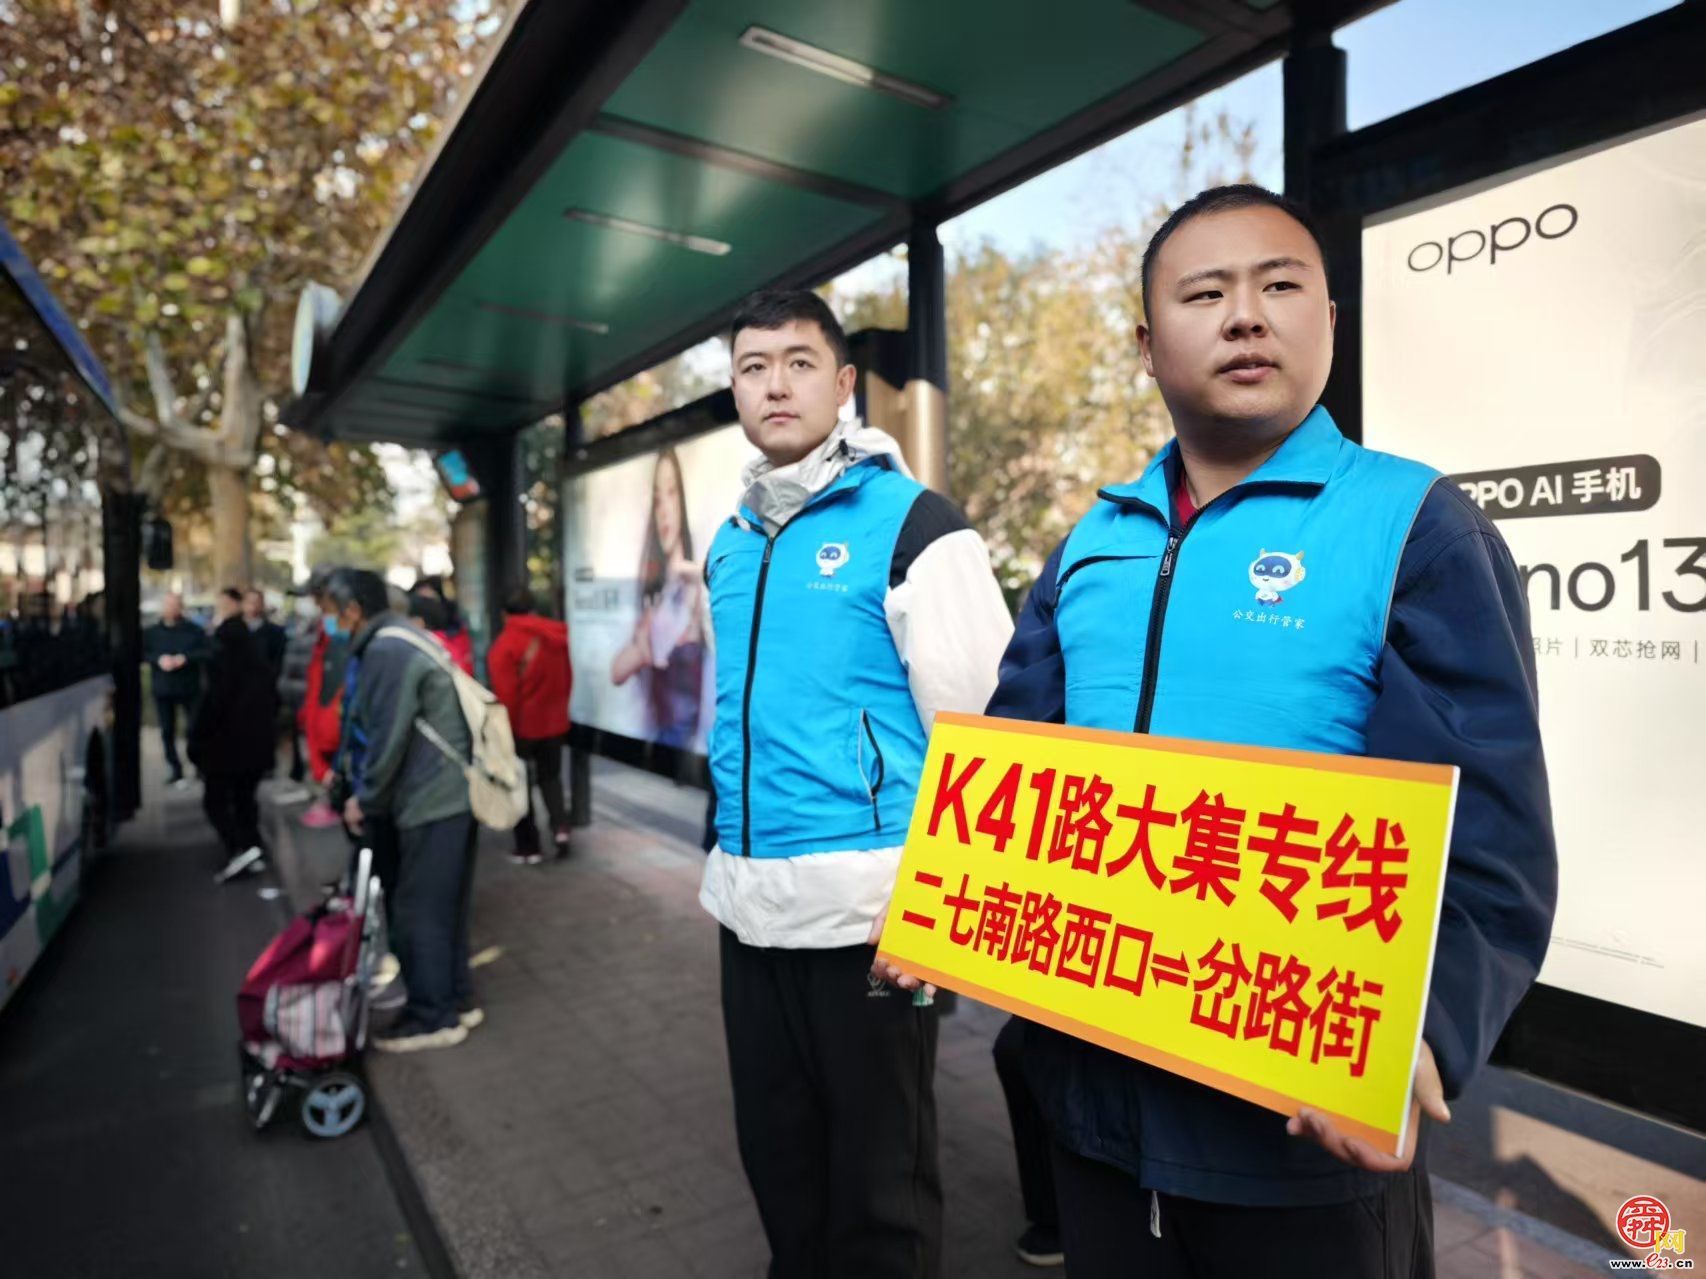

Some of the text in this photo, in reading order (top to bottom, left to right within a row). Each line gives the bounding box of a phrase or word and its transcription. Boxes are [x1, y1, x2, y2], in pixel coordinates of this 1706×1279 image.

[1408, 203, 1578, 275] oppo
[1458, 466, 1642, 510] PPO AI 手机
[1519, 537, 1706, 613] no13
[1233, 608, 1305, 629] 公交出行管家
[1589, 637, 1681, 660] 双芯抢网
[928, 753, 1409, 943] K41路大集专线
